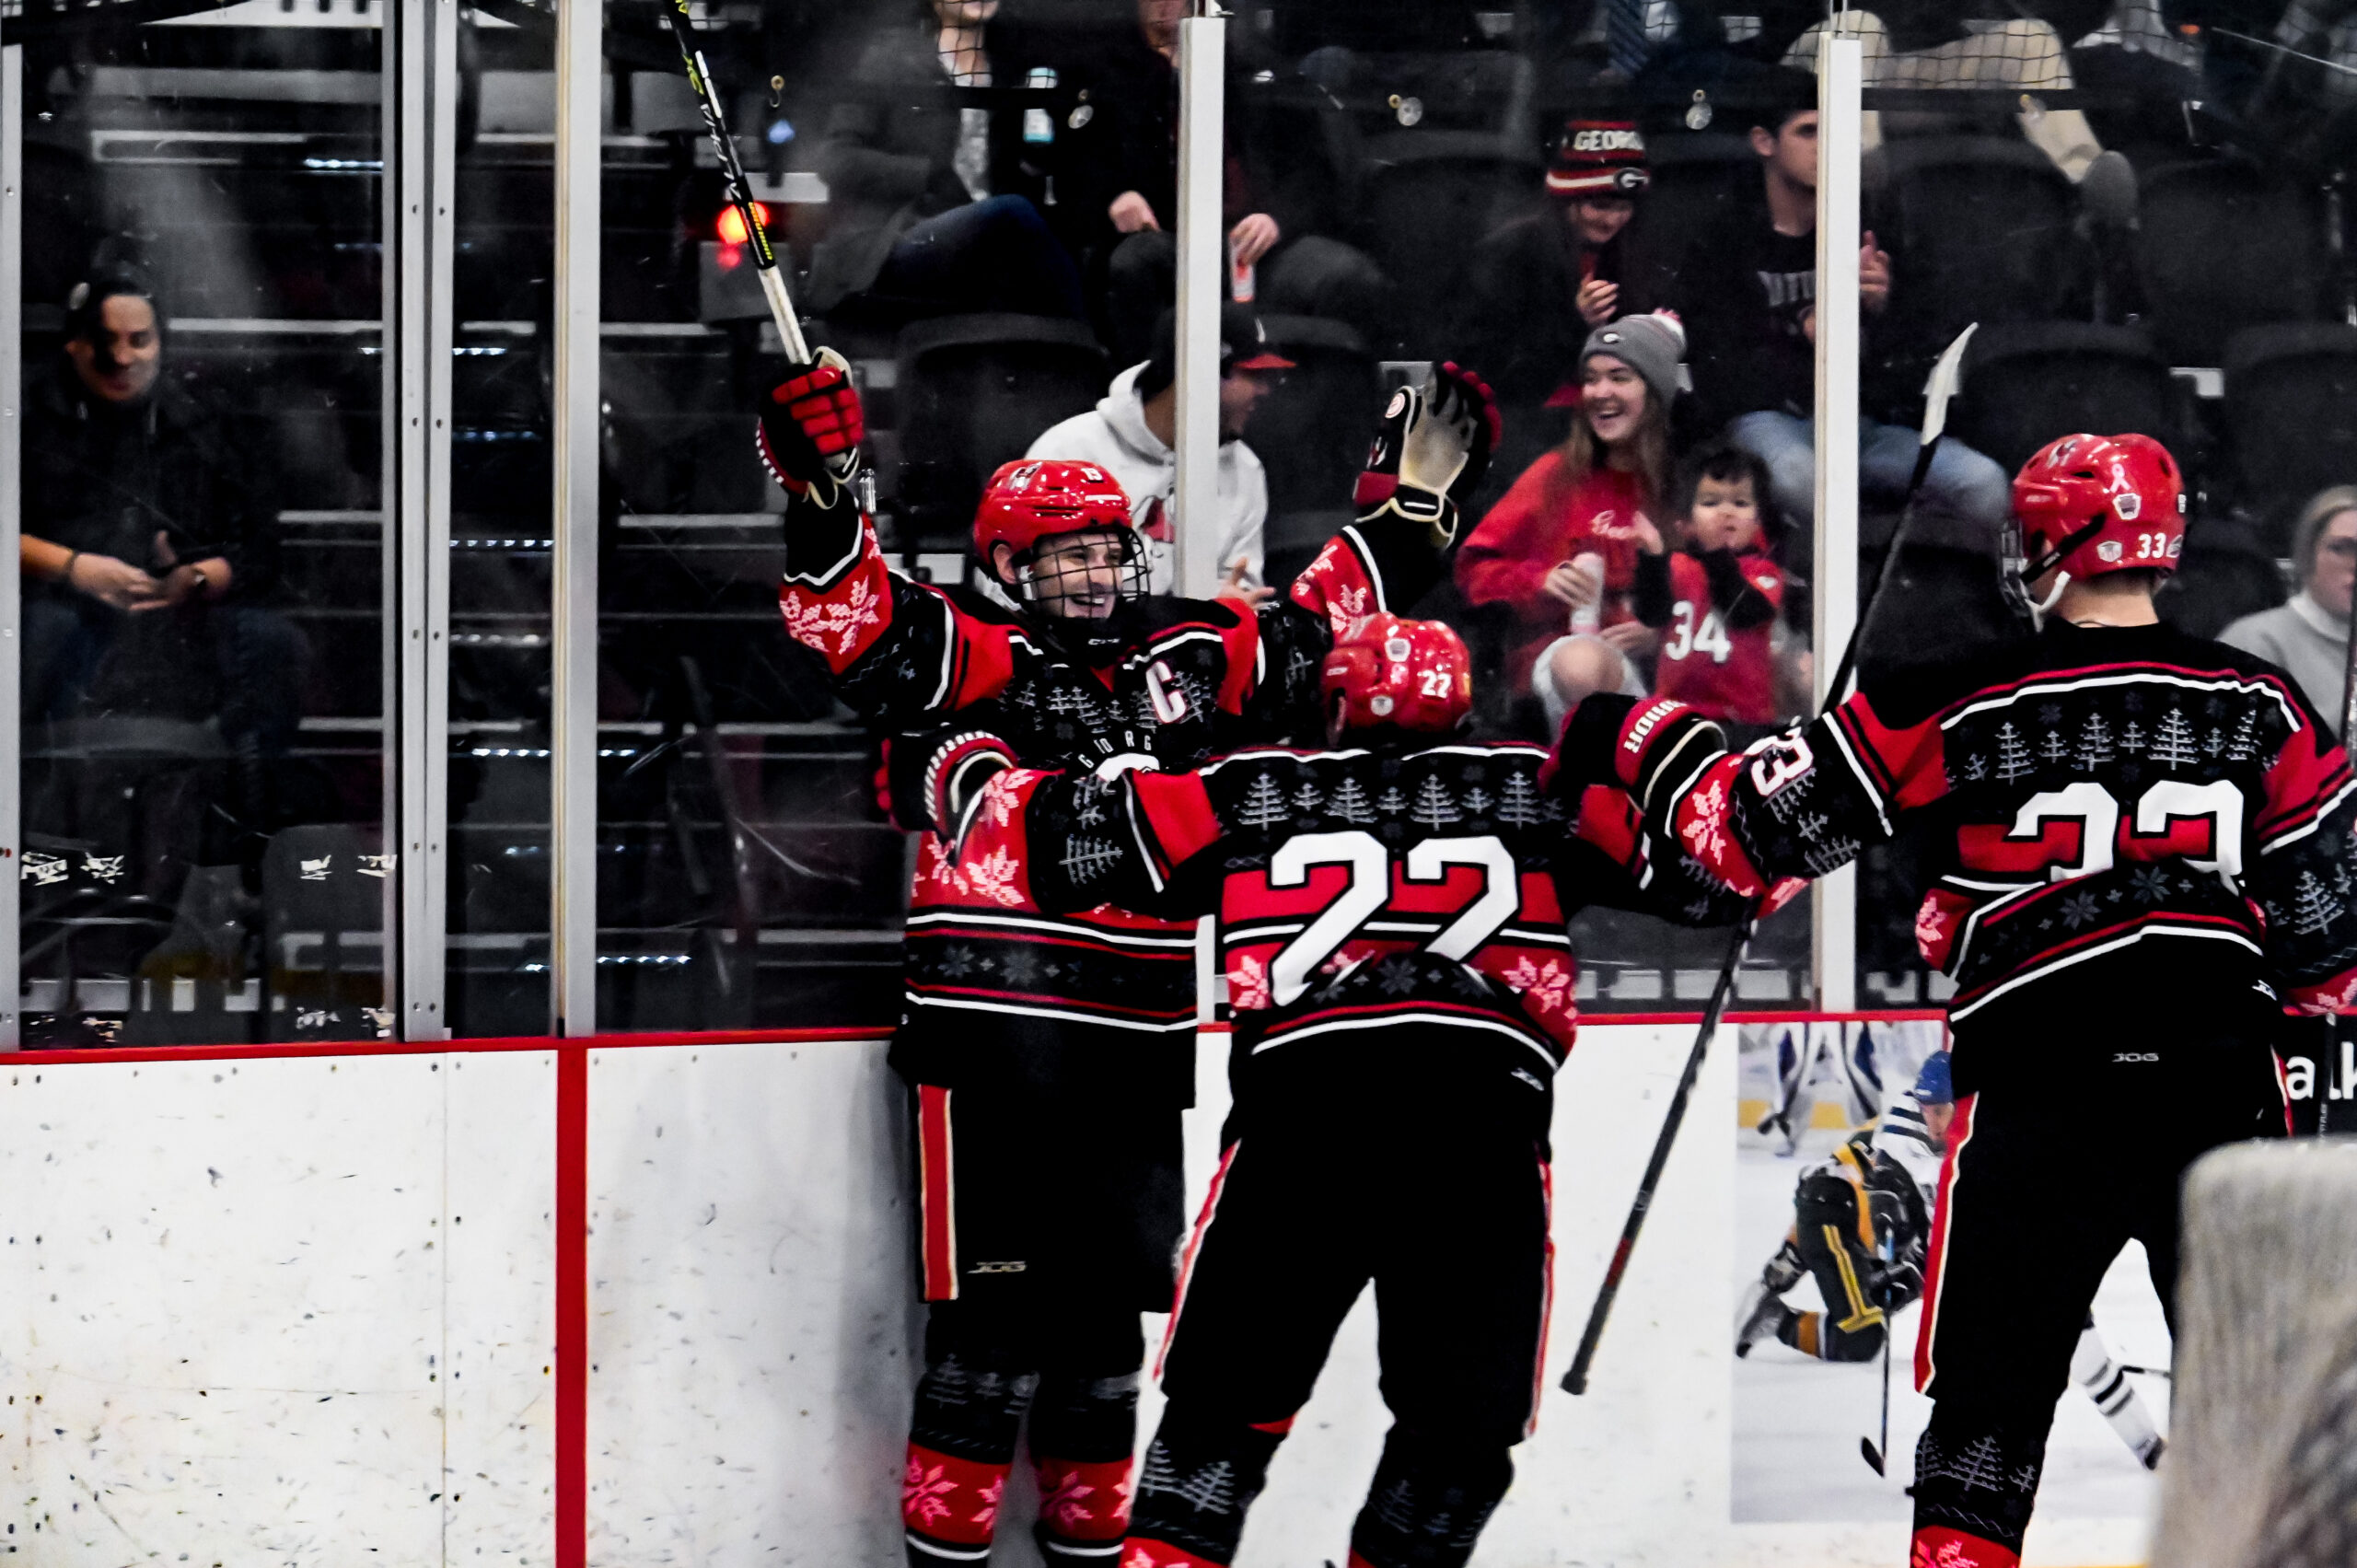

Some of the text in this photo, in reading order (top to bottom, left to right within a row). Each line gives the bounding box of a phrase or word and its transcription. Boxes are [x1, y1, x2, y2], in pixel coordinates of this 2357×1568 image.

[2136, 531, 2167, 559] 33
[1665, 600, 1734, 664] 34
[1144, 658, 1188, 725] C
[1271, 830, 1519, 1006] 22
